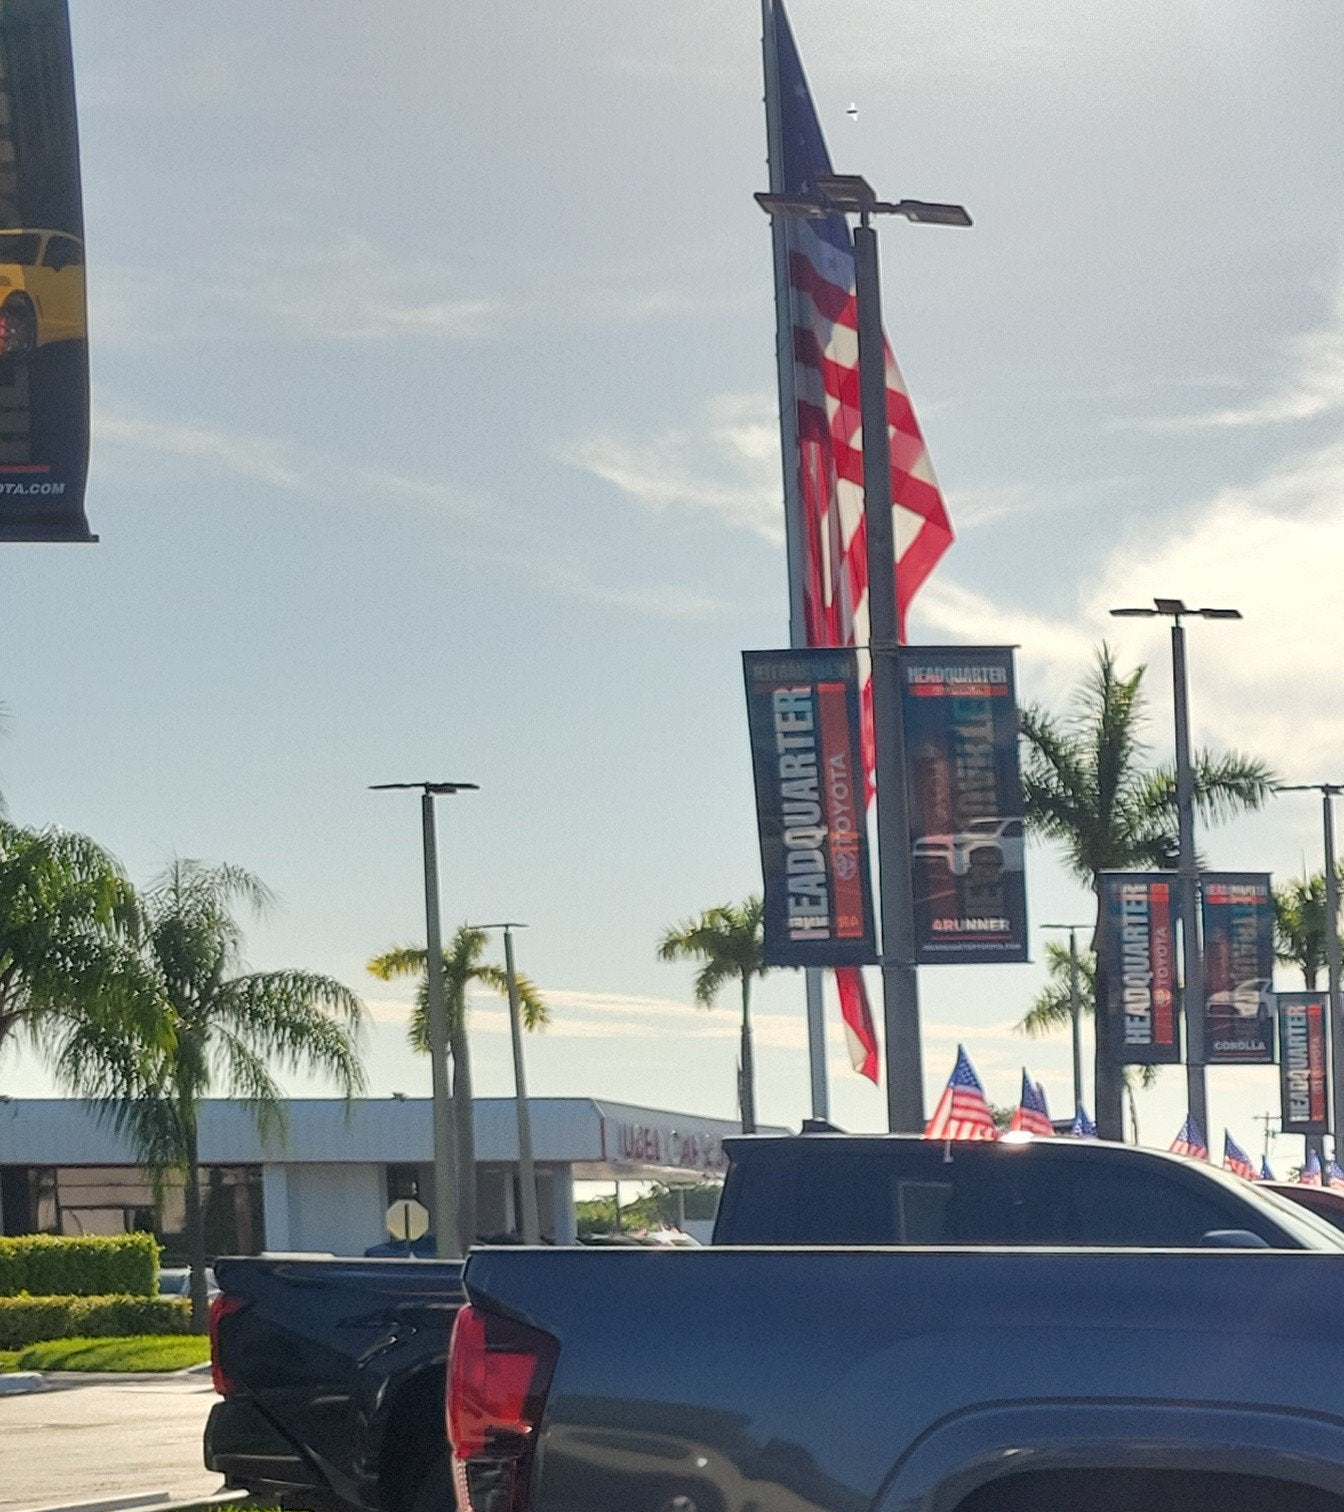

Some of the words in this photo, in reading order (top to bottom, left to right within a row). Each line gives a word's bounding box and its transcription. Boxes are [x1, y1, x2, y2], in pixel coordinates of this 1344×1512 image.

[774, 685, 831, 941] HEADQUARTER
[829, 752, 852, 849] TOYOTA
[1122, 884, 1153, 1044] HEADQUARTER
[1214, 1039, 1266, 1051] COROLLA
